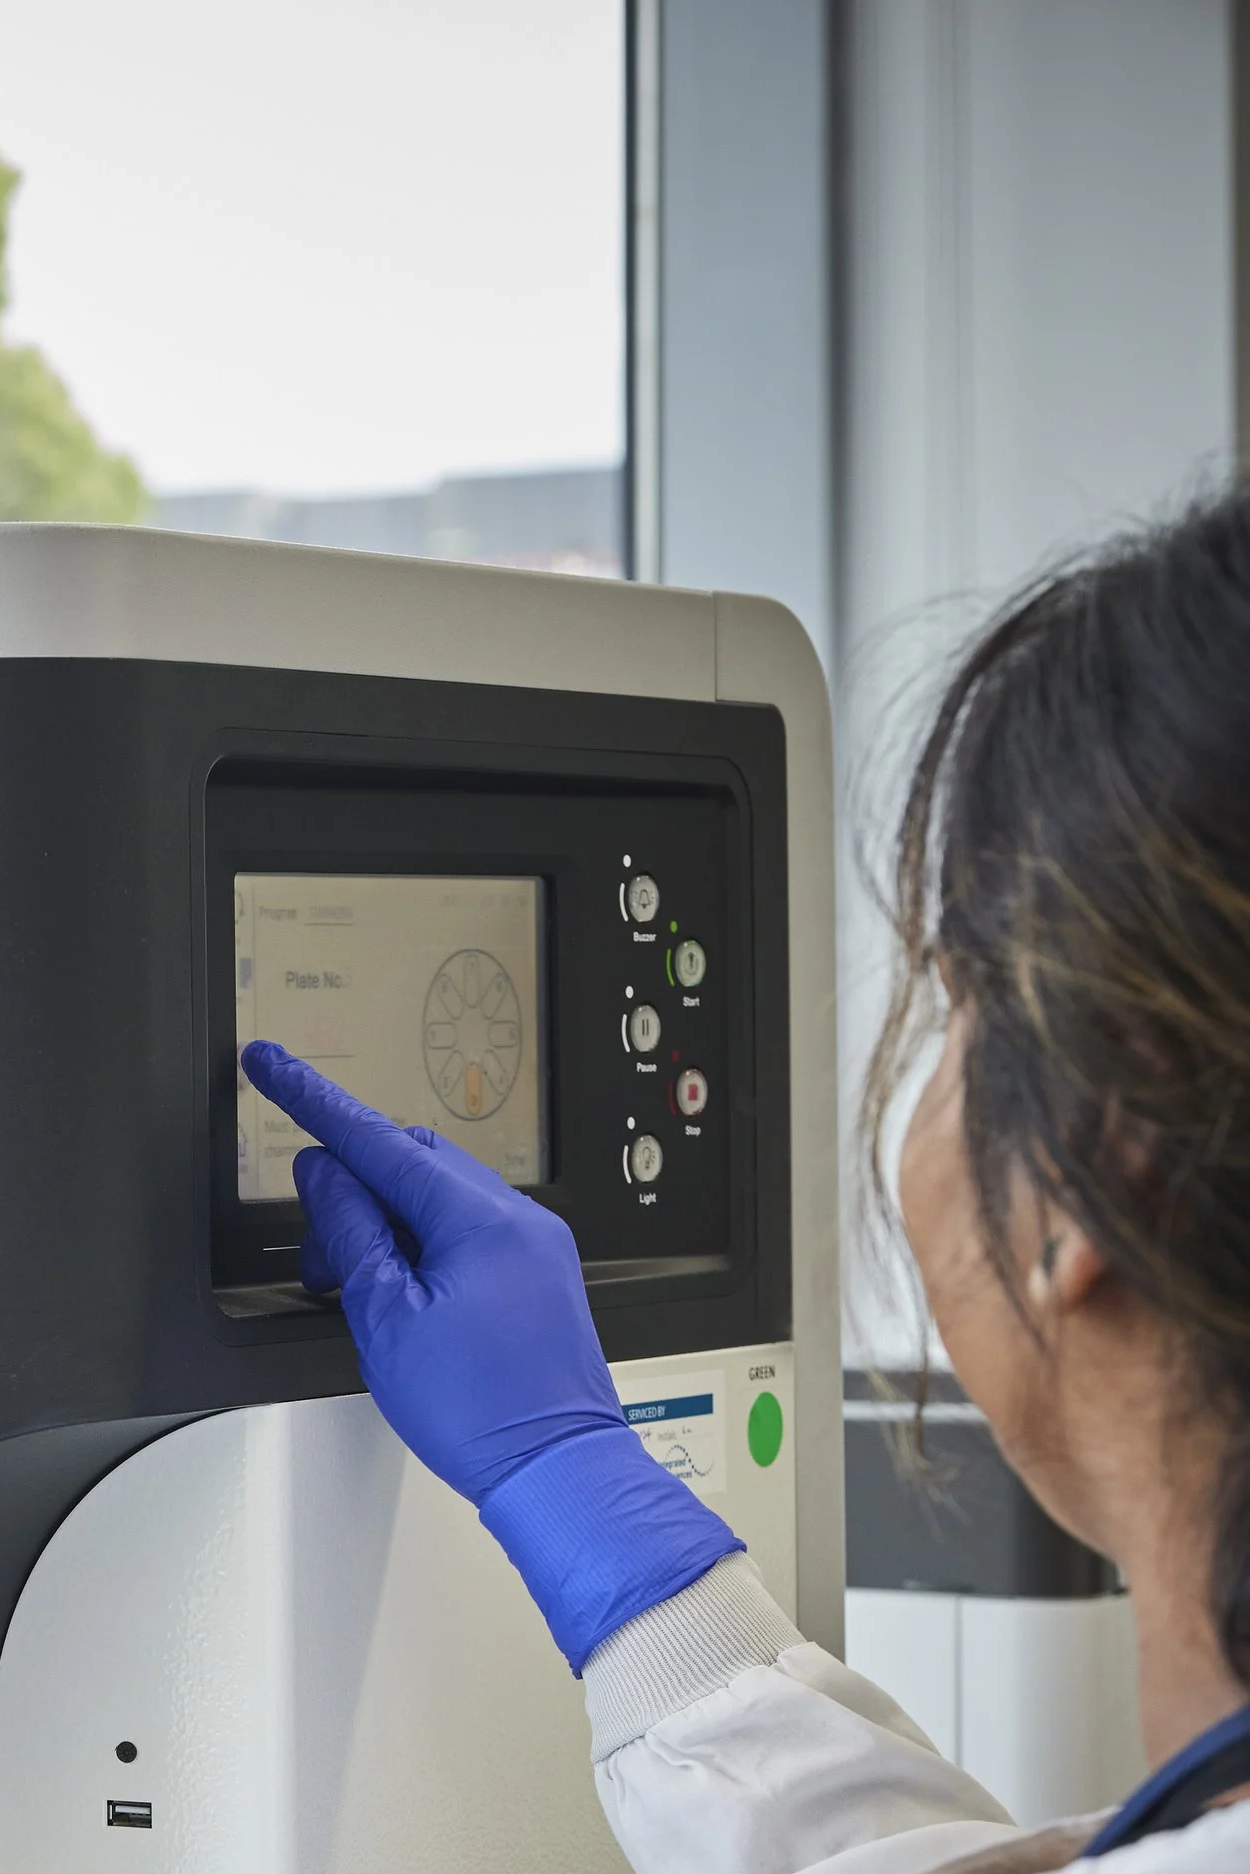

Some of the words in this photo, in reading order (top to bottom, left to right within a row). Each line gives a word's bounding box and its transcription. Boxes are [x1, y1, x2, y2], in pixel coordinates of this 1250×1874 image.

[285, 970, 320, 989] Plate
[683, 996, 700, 1007] Start
[636, 1062, 657, 1073] Pause
[685, 1125, 701, 1136] Stop
[639, 1193, 657, 1205] Light
[748, 1364, 776, 1381] GREEN
[627, 1406, 657, 1421] SERVICED
